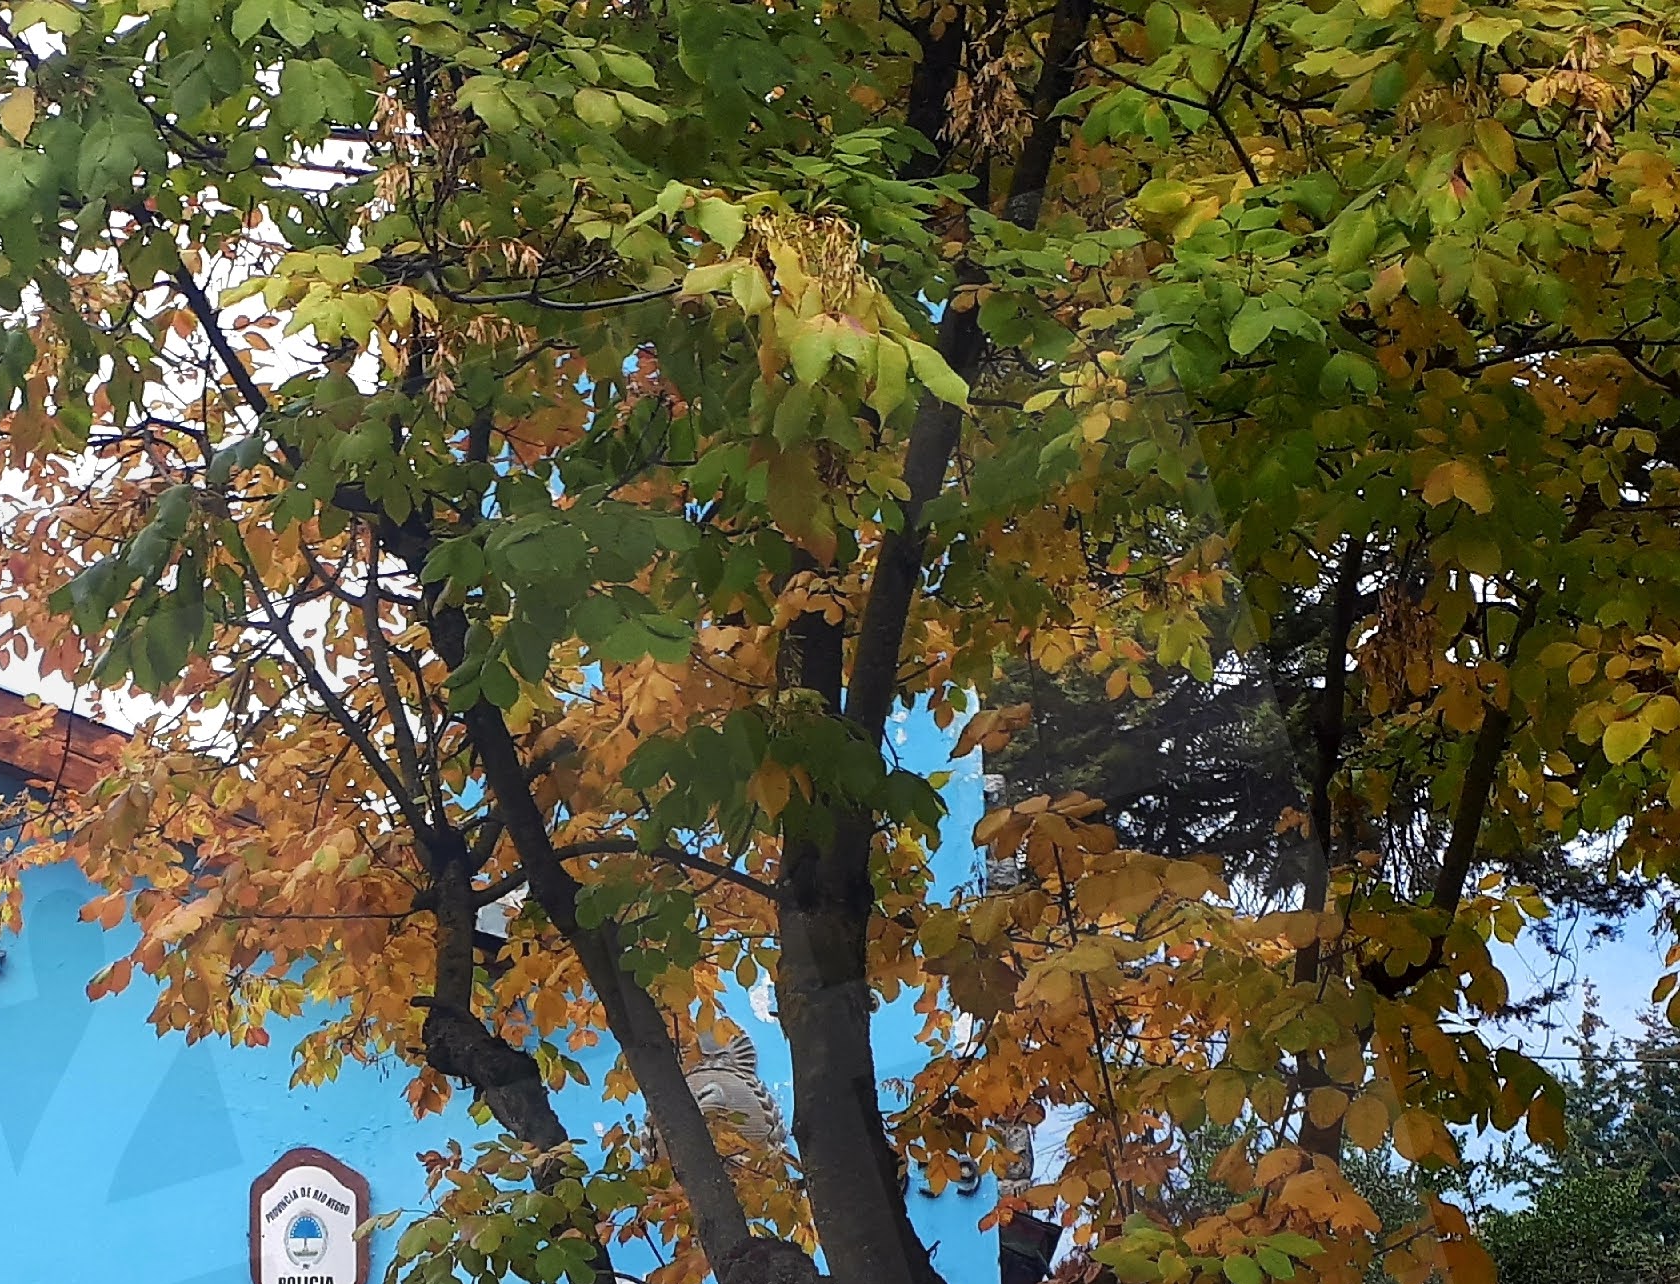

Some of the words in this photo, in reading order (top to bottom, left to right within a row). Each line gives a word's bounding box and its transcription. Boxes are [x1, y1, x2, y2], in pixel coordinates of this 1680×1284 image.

[265, 1190, 299, 1224] PROVINCIA
[300, 1187, 312, 1198] DE
[312, 1189, 328, 1204] RIO
[325, 1197, 351, 1216] NEGRO
